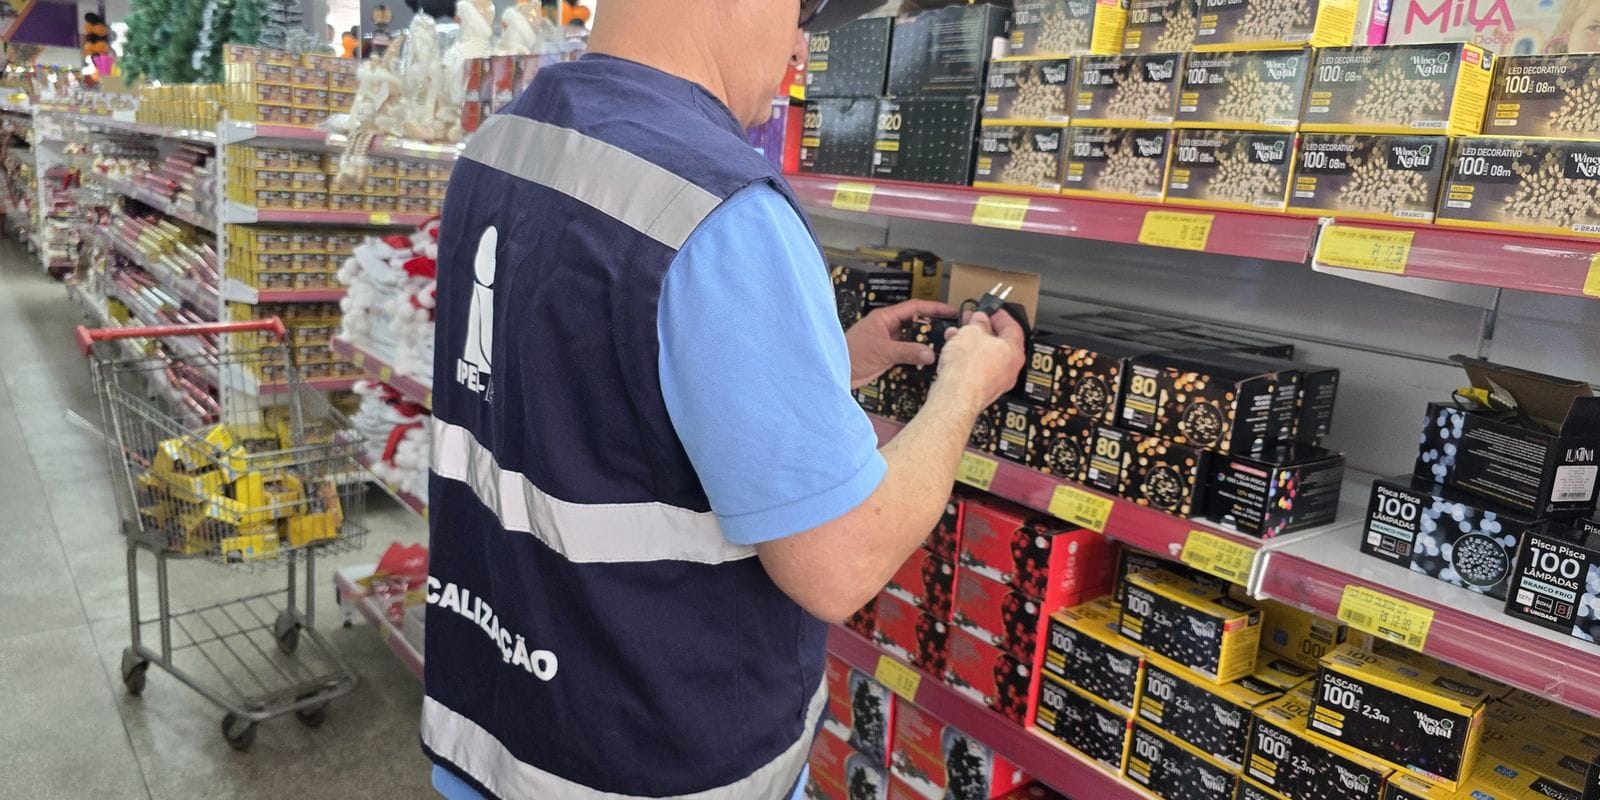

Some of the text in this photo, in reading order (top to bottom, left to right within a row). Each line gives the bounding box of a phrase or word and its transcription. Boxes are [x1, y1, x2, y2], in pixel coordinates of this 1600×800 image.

[1188, 68, 1206, 84] 100
[1319, 66, 1361, 82] 100 08m
[1414, 63, 1447, 77] Natal
[1508, 66, 1567, 75] LED DECORATIVO
[1504, 75, 1530, 94] 100
[1536, 82, 1556, 93] 08m
[804, 112, 822, 129] 320
[877, 113, 902, 130] 320
[1178, 147, 1195, 162] 100
[1303, 151, 1346, 169] 100 08m
[1393, 146, 1419, 157] Wincy
[1397, 154, 1431, 168] Natal
[1462, 148, 1522, 157] LED DECORATIVO
[1458, 157, 1484, 176] 100
[1490, 165, 1511, 177] 08m
[1032, 352, 1053, 372] 80
[1131, 375, 1157, 397] 80
[1006, 411, 1026, 431] 80
[1096, 437, 1121, 459] 80
[1378, 486, 1421, 504] Pisca Pisca
[1377, 494, 1416, 521] 100
[1372, 512, 1416, 530] LÂMPADAS
[1531, 538, 1586, 560] Pisca Pisca
[1530, 547, 1580, 579] 100
[1524, 567, 1579, 590] LÂMPADAS
[1523, 580, 1573, 600] BRANCO FRIO
[1128, 594, 1149, 617] 100
[1052, 631, 1072, 653] 100
[1147, 676, 1195, 713] 100 2,3m
[1324, 674, 1364, 695] CASCATA
[1043, 688, 1063, 710] 100
[1323, 683, 1354, 710] 100
[1362, 705, 1390, 724] 2,3m
[1413, 710, 1440, 726] Wincy
[1258, 724, 1292, 746] CASCATA
[1419, 720, 1452, 739] Natal
[1136, 737, 1182, 776] 100 2,3m
[1257, 733, 1315, 775] 100 2,3m
[1340, 774, 1369, 794] Natal
